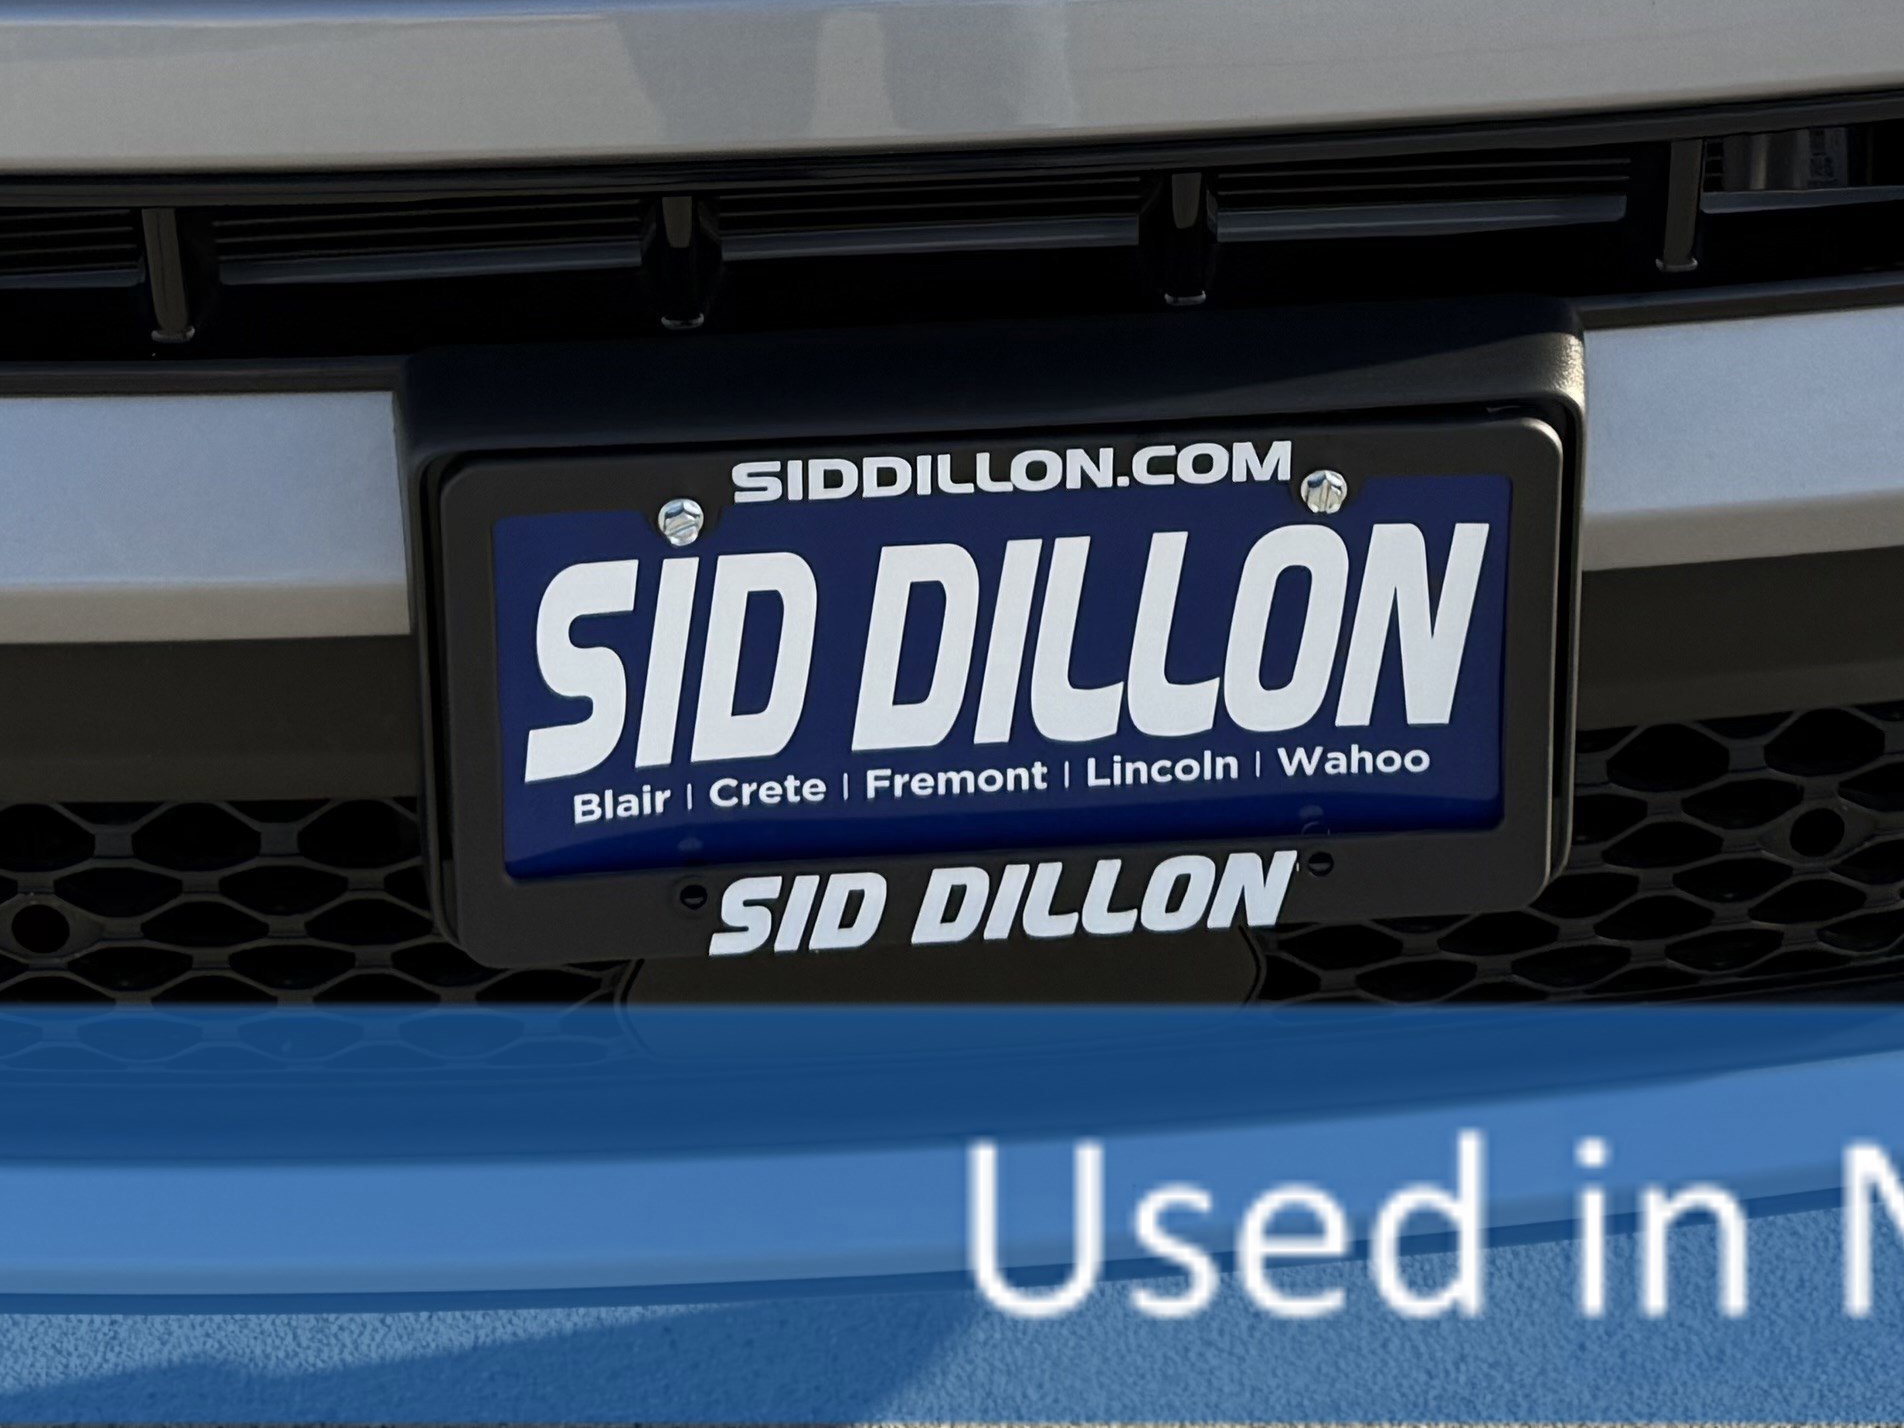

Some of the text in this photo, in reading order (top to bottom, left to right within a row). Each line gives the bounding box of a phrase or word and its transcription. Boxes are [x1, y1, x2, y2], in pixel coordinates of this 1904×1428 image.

[731, 440, 1293, 503] SIDDILLON.COM
[524, 522, 1490, 783] SID DILLON
[573, 743, 1431, 825] Blair Crete Fremont Lincoln Wahoo
[708, 849, 1298, 956] SID DILLON
